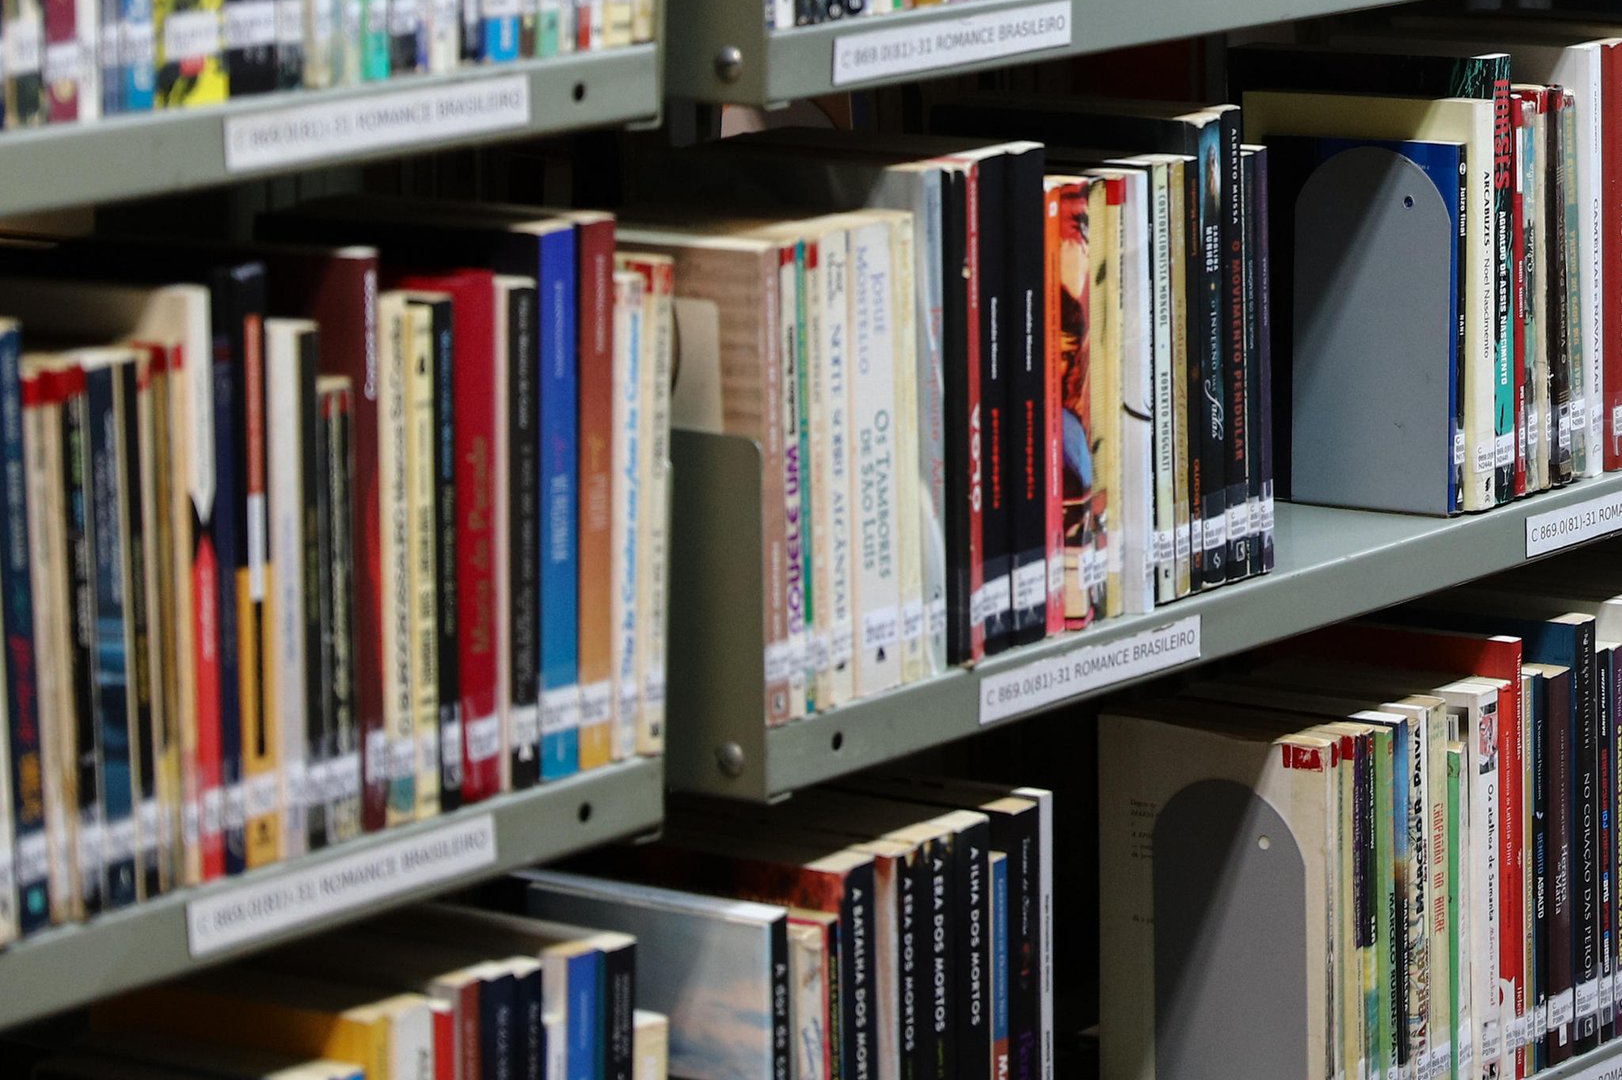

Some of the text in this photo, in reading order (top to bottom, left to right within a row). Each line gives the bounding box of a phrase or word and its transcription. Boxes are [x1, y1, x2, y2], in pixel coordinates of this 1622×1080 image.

[1230, 128, 1239, 180] ALBERTO
[1231, 184, 1239, 224] MUSSA
[1232, 258, 1242, 364] MOVIMENTO
[1482, 171, 1492, 358] ARCABUZES Noel Nascimento
[1499, 211, 1508, 384] AGNALDO DE ASSIS NASCIMENTO
[1159, 372, 1169, 472] ROBERTO MUGGIATI
[1233, 370, 1244, 461] PENDULAR
[1532, 528, 1537, 542] C
[1540, 512, 1596, 540] 869.0(81)-31
[986, 630, 1195, 706] C 869.0(81)-31 ROMANCE BRASILEIRO
[1581, 773, 1592, 920] NO CORAÇÃO DAS
[933, 859, 945, 1031] A ERA DOS MORTOS
[970, 848, 980, 1025] A ILHA DOS MORTOS
